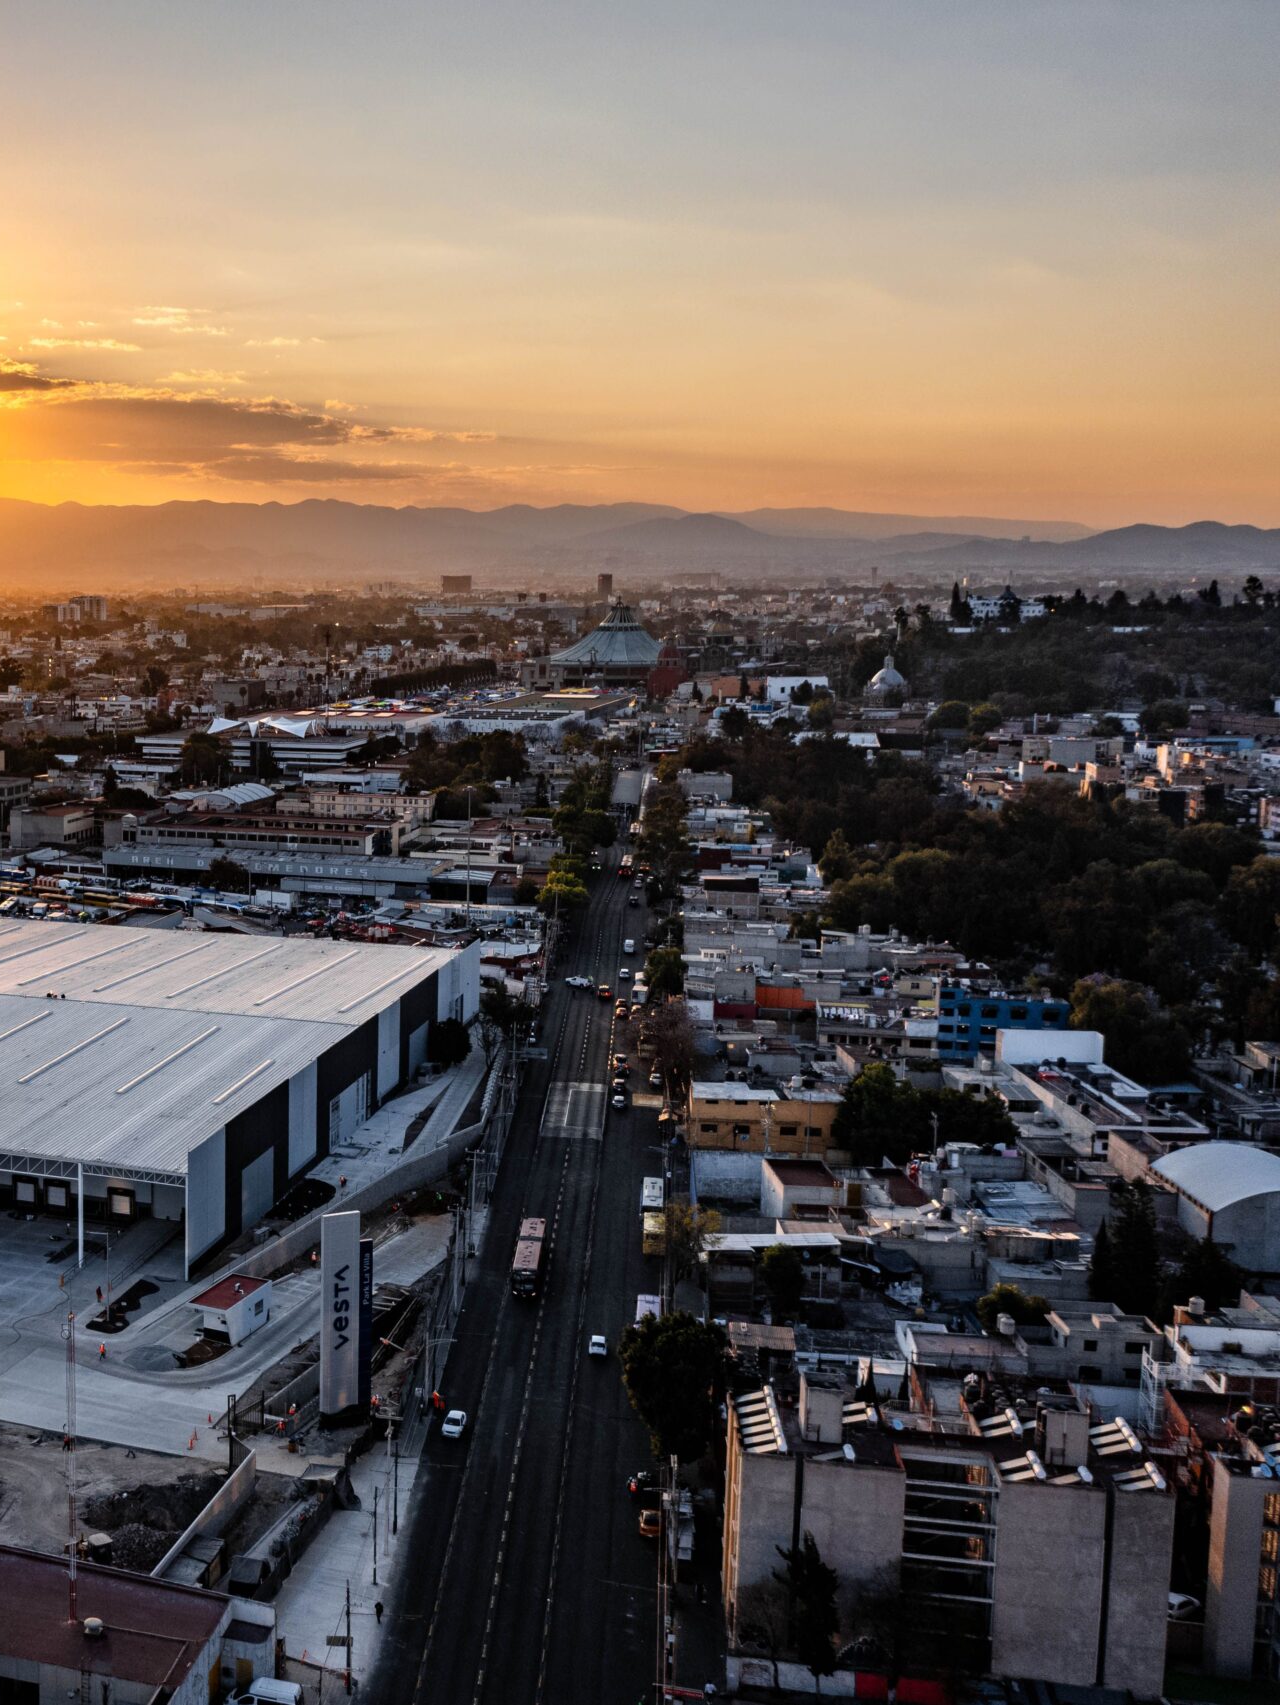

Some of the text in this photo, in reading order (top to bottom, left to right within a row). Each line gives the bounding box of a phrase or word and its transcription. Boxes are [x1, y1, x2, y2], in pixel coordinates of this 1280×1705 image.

[362, 1253, 370, 1305] Park La Villa
